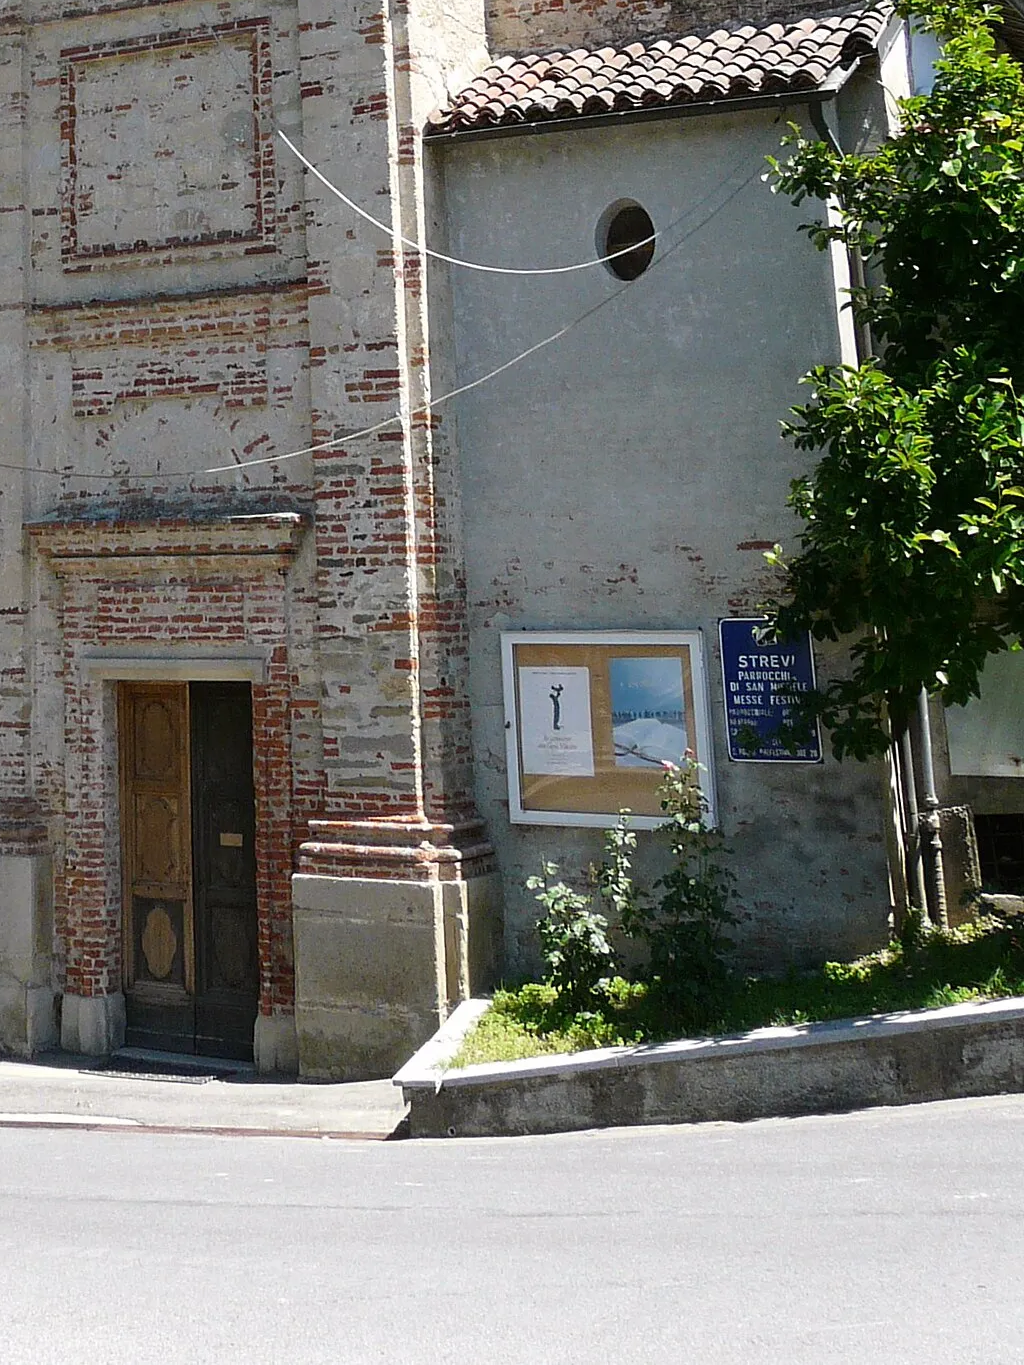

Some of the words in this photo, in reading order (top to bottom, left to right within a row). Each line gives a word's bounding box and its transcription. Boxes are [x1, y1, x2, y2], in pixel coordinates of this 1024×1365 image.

[738, 655, 795, 668] STREVI
[730, 682, 739, 692] DI
[746, 682, 764, 691] SAN
[733, 695, 764, 705] MESSE
